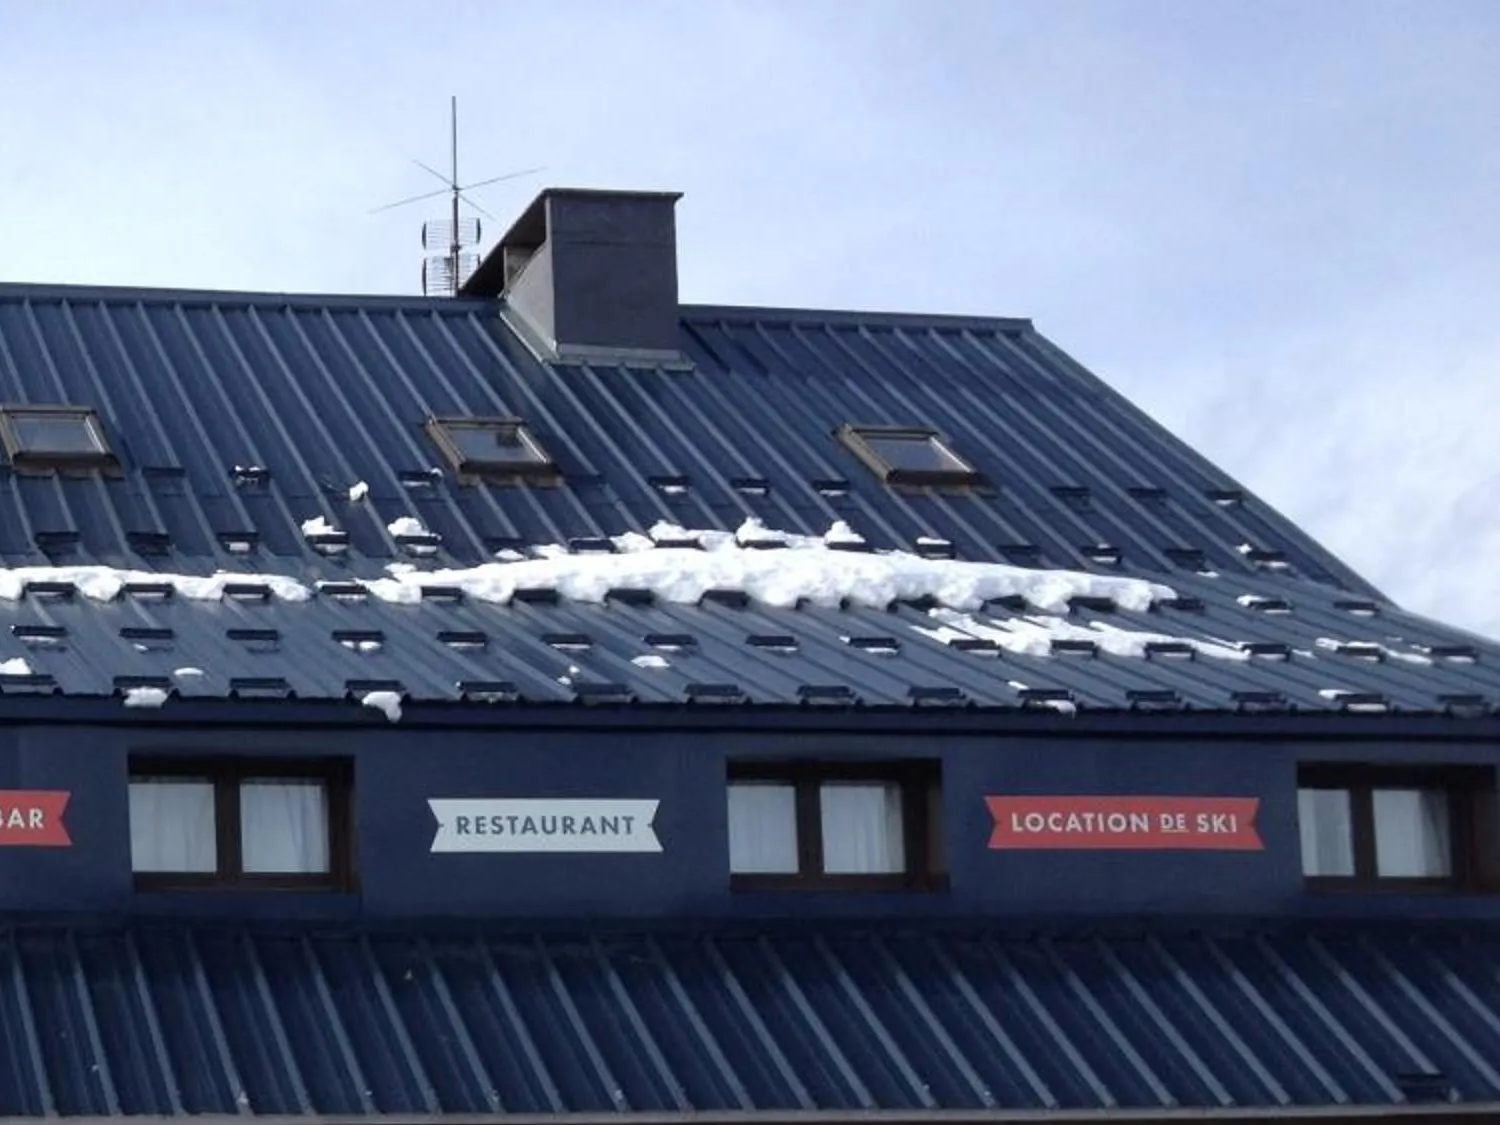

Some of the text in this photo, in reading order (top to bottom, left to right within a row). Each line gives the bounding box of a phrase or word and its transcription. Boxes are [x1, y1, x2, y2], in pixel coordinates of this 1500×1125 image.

[455, 815, 635, 836] RESTAURANT
[1011, 812, 1238, 833] LOCATION DE SKI
